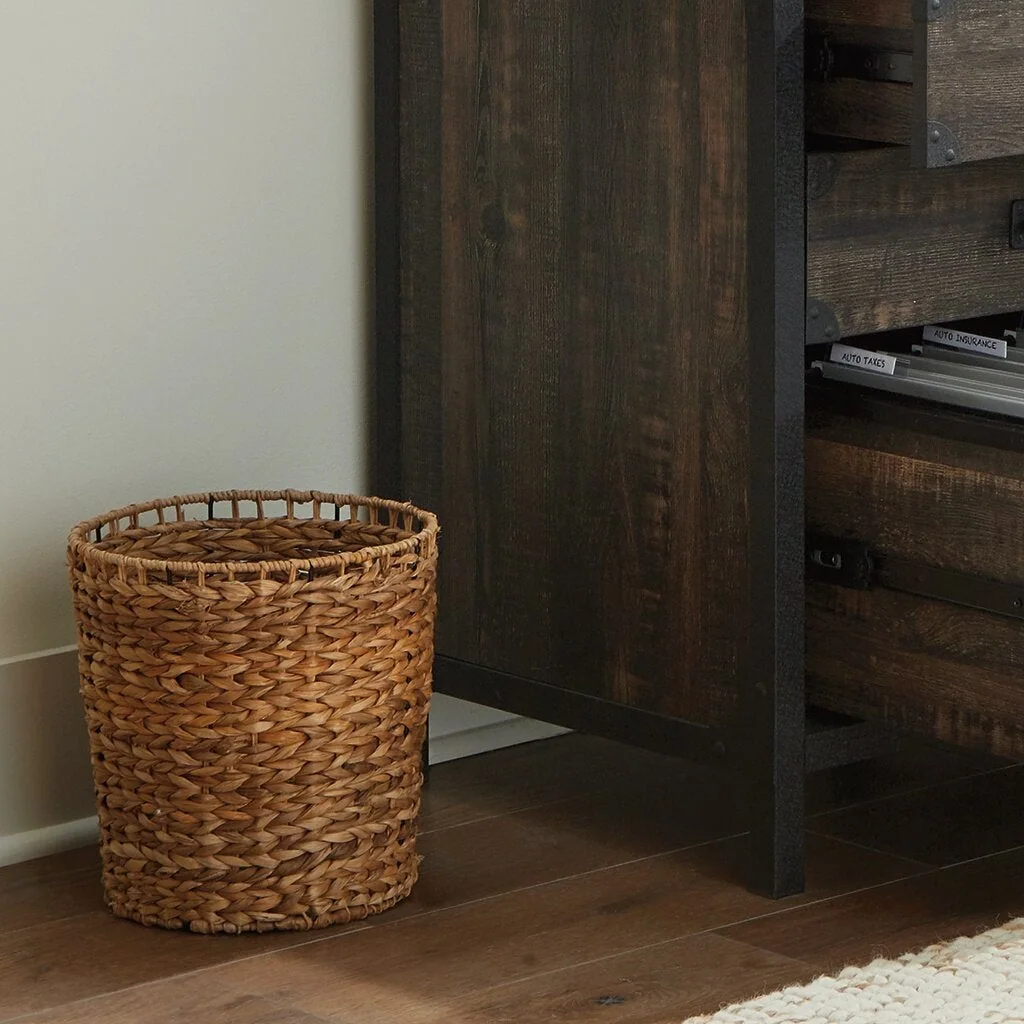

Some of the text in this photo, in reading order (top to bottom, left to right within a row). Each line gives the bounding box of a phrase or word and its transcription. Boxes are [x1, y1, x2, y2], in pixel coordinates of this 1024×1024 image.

[934, 329, 997, 350] AUTO INSURANCE
[841, 353, 886, 369] AUTO TAXES
